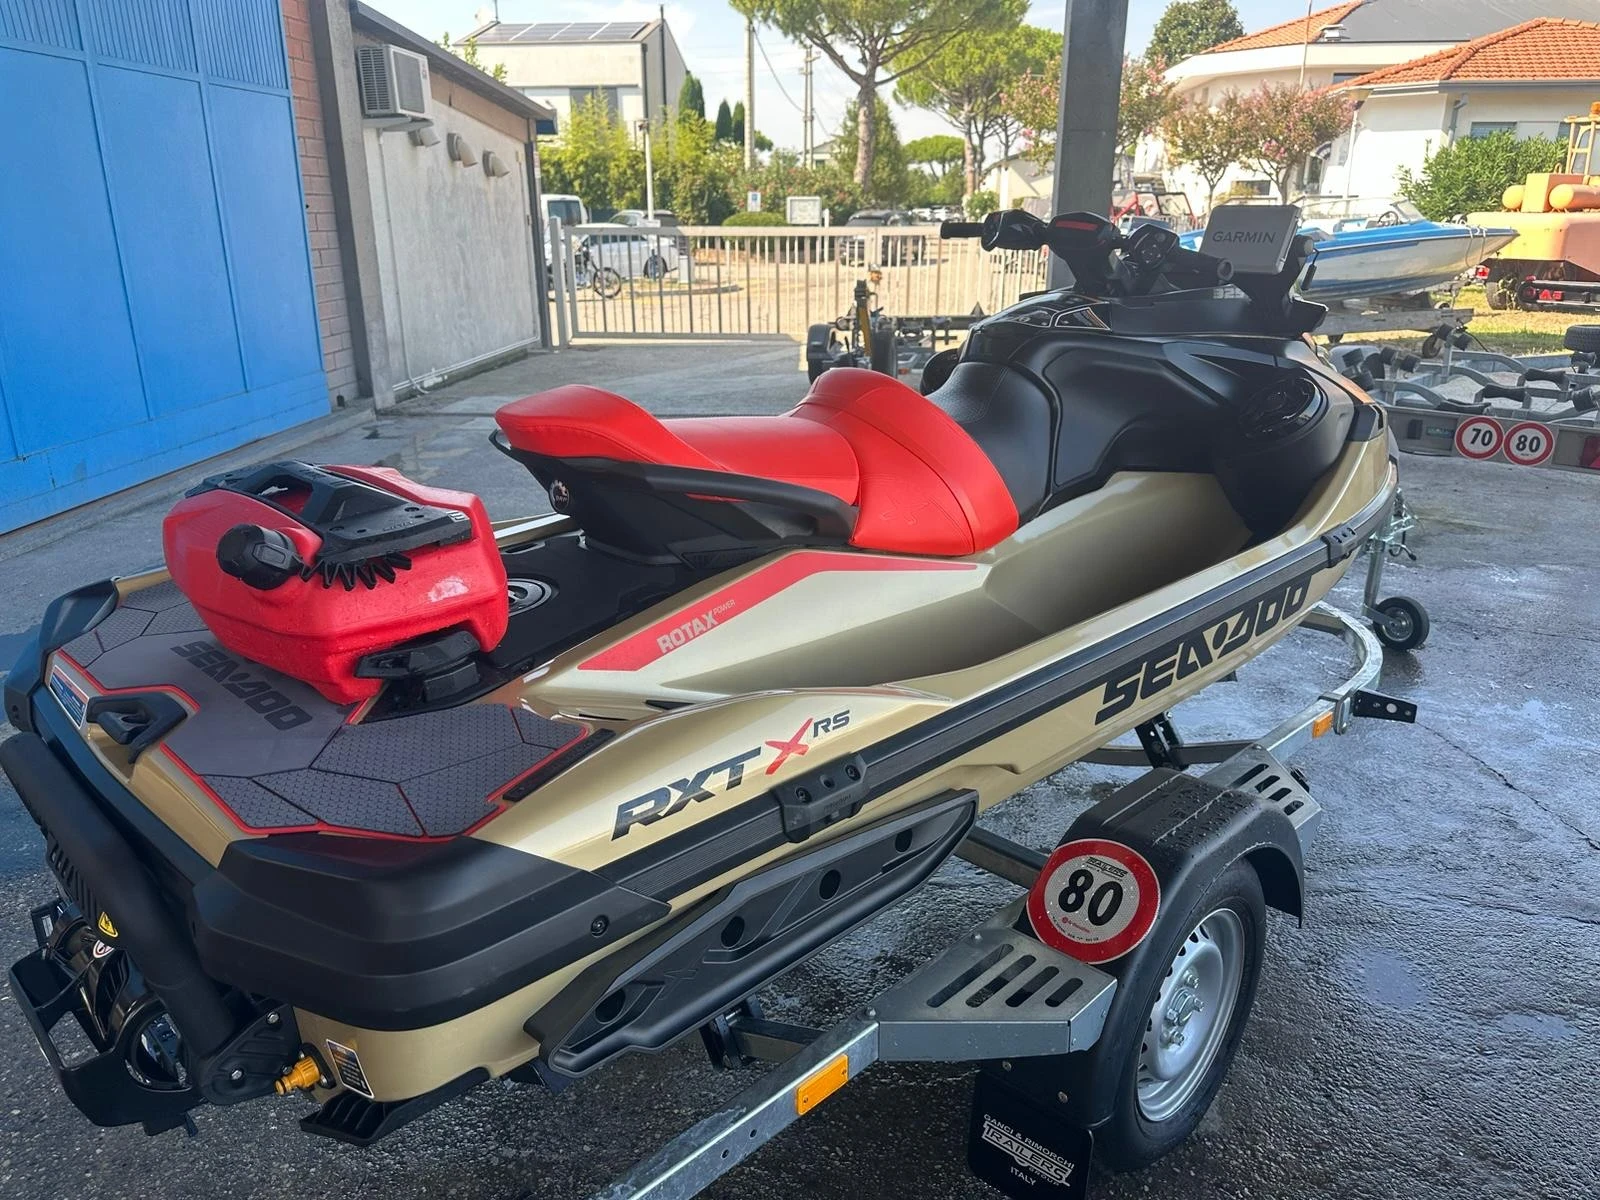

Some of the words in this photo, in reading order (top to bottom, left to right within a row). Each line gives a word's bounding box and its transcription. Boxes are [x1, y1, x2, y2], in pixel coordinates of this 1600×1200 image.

[1212, 231, 1276, 243] GARMIN
[1470, 428, 1493, 446] 70
[1515, 434, 1541, 453] 80
[656, 610, 718, 653] ROTAX
[712, 599, 736, 616] POWER
[611, 746, 762, 841] RXT
[813, 709, 850, 738] RS
[1058, 868, 1124, 926] 80
[982, 1120, 1073, 1187] TRAILERS
[983, 1113, 1014, 1135] GANCI
[1015, 1132, 1023, 1140] &
[1024, 1137, 1075, 1169] RIMORCHI
[1010, 1166, 1037, 1186] ITALY
